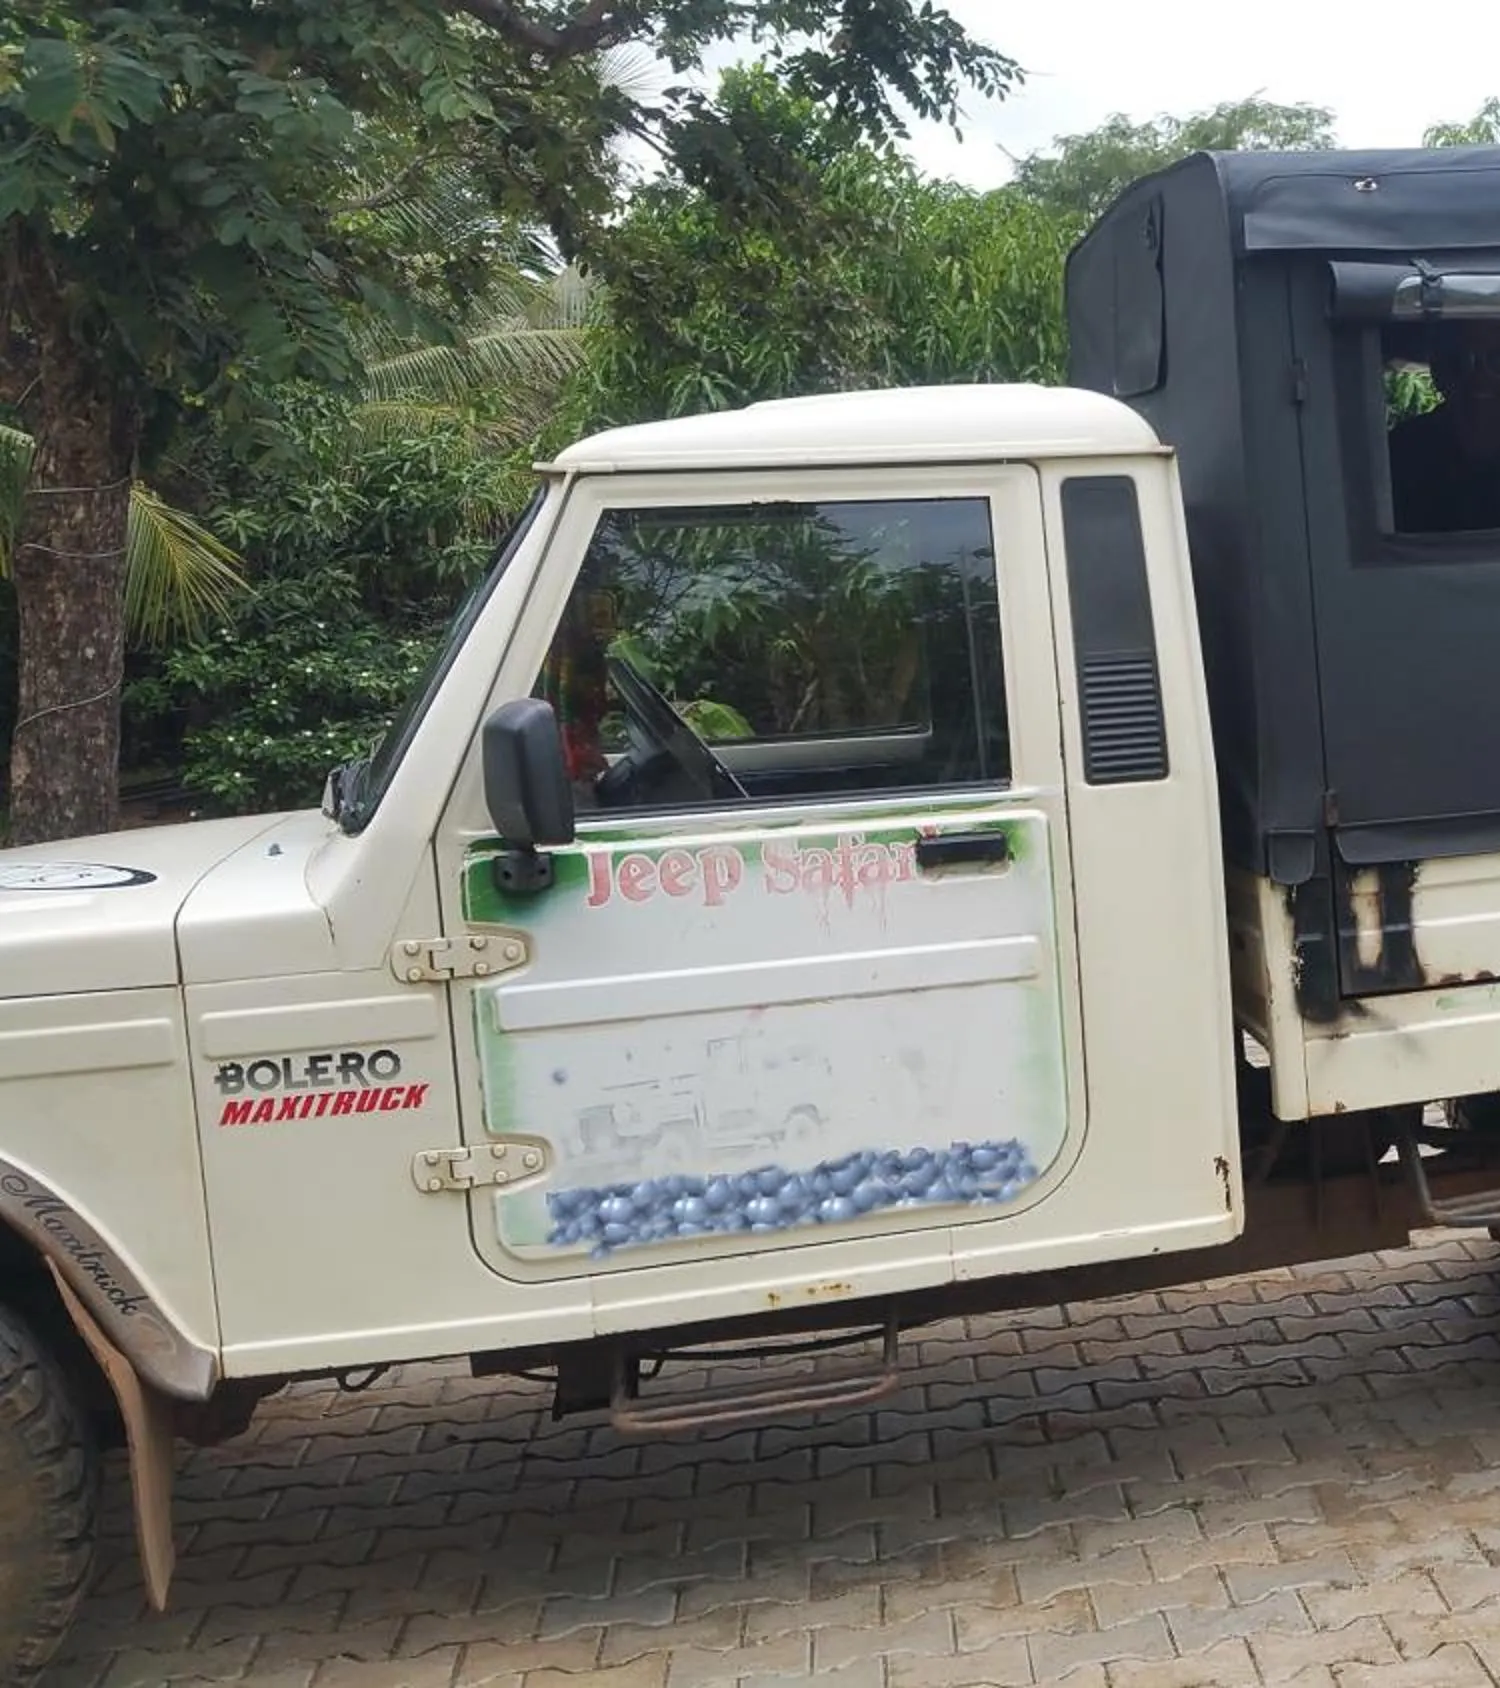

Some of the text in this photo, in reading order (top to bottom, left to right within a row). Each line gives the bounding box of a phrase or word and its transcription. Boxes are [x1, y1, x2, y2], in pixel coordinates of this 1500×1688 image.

[586, 824, 944, 907] Jeep Safar
[214, 1049, 401, 1095] BOLERO
[219, 1083, 429, 1126] MAXITRUCK
